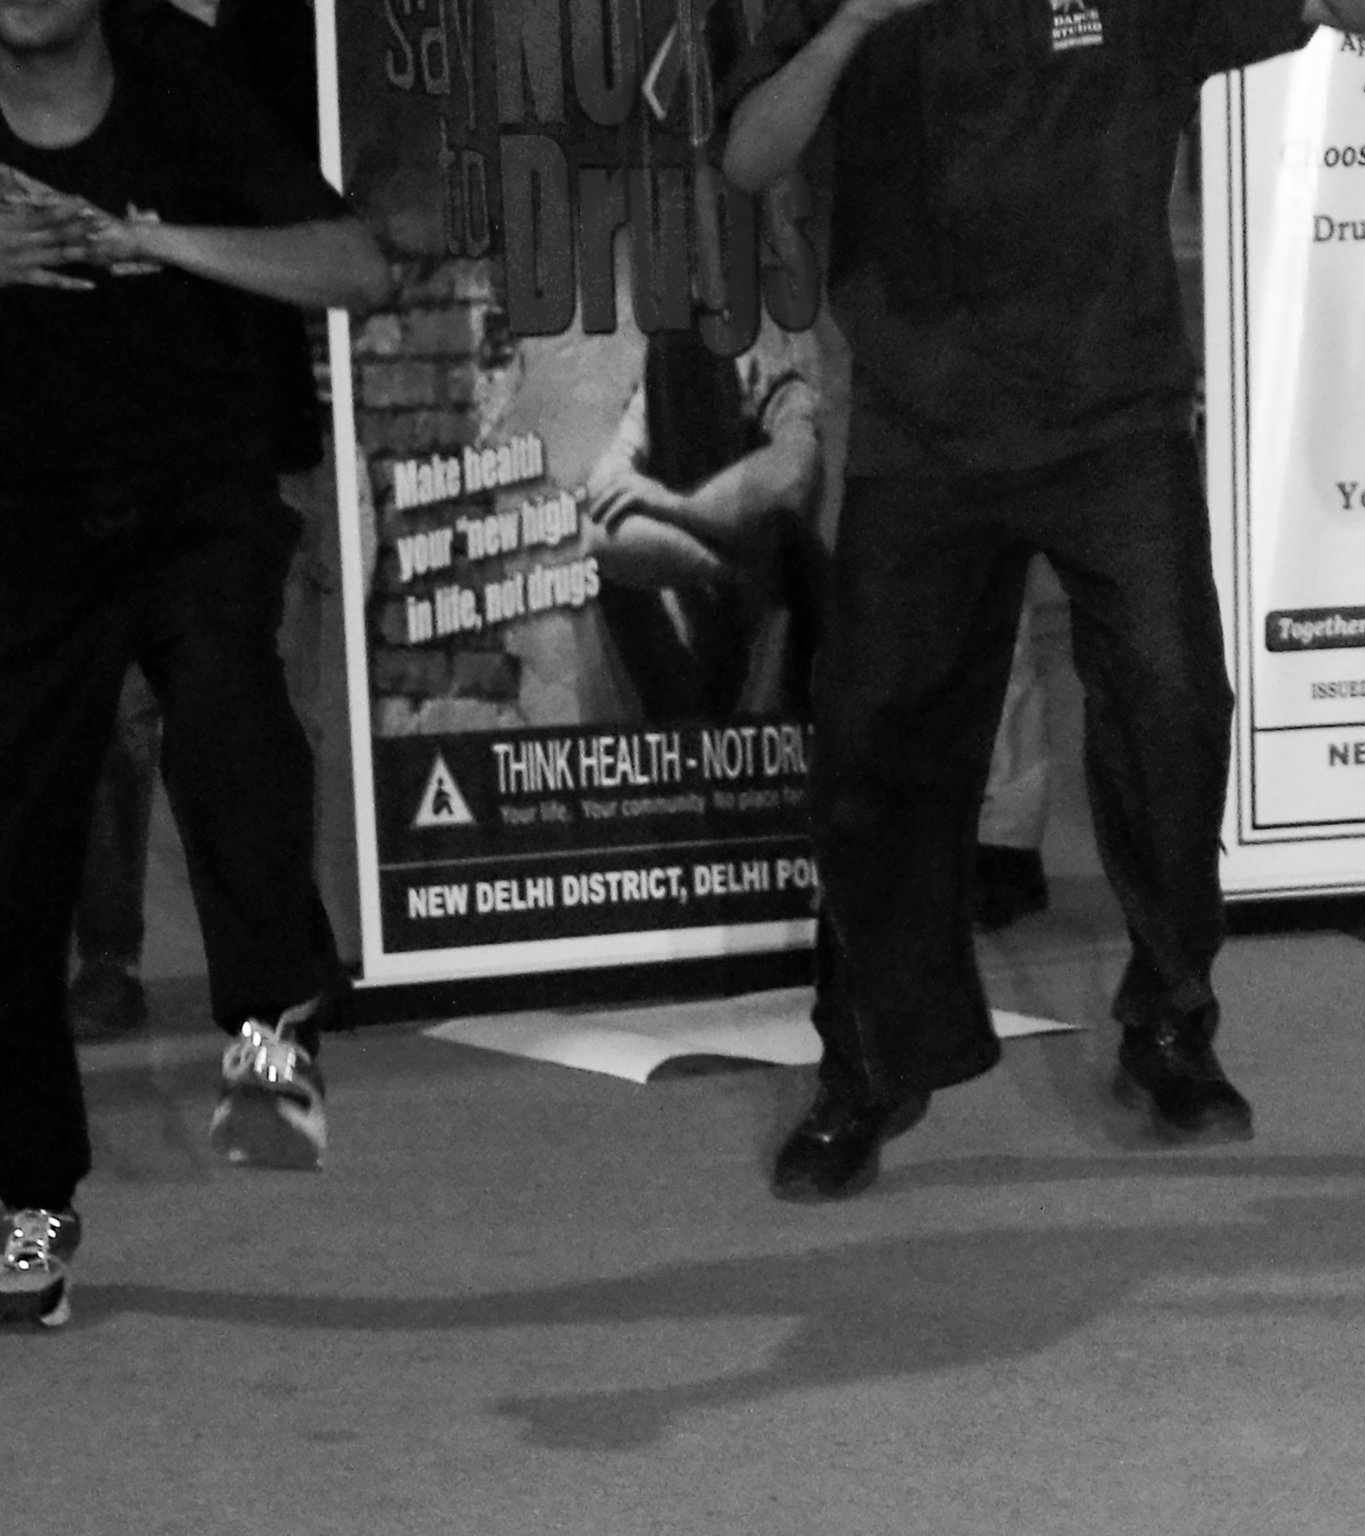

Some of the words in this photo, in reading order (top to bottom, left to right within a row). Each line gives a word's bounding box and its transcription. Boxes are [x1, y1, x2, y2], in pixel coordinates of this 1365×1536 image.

[394, 453, 461, 510] Make
[463, 432, 543, 494] health
[397, 526, 454, 584] your
[407, 595, 433, 644] in
[436, 583, 483, 638] life,
[484, 571, 525, 623] not
[526, 556, 600, 612] drugs
[493, 737, 575, 794] THINK
[578, 731, 682, 788] HEALTH
[701, 725, 757, 780] NOT
[407, 883, 470, 920] NEW
[475, 877, 555, 913] DELHI
[560, 867, 688, 907] DISTRICT,
[694, 861, 769, 896] DELHI
